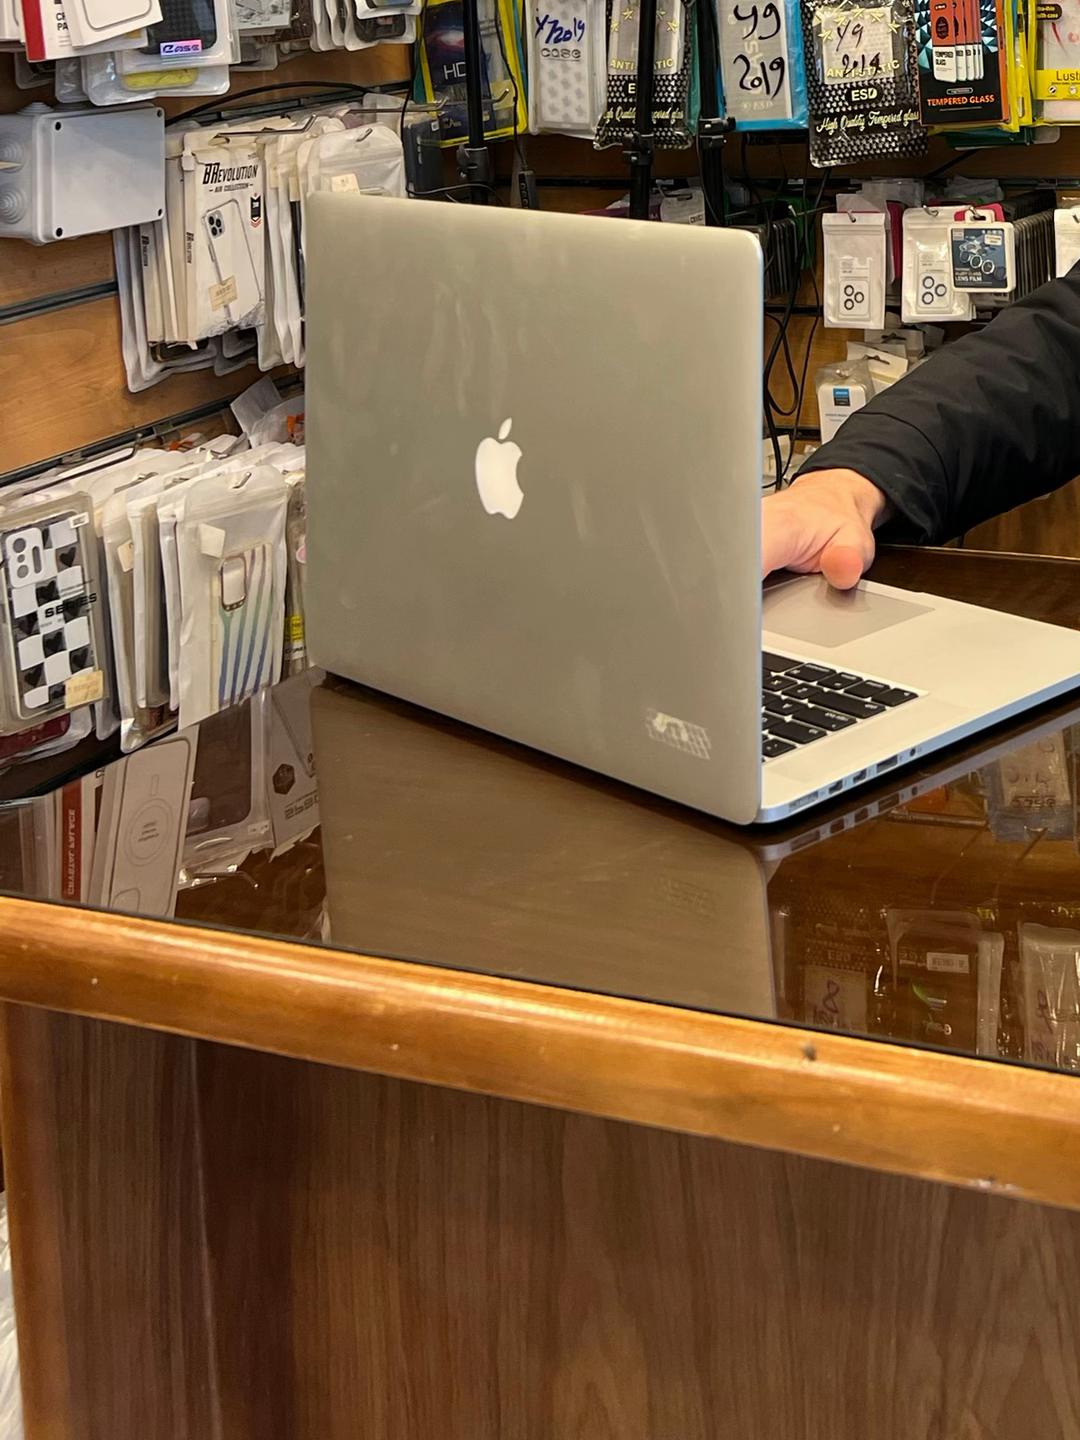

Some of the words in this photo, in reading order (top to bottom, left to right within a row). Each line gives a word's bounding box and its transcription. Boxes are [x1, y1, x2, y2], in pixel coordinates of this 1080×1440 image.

[540, 47, 581, 59] case
[851, 88, 878, 101] ESD
[927, 95, 968, 107] TEMPERED
[969, 94, 995, 104] GLASS
[45, 592, 98, 619] SERIES
